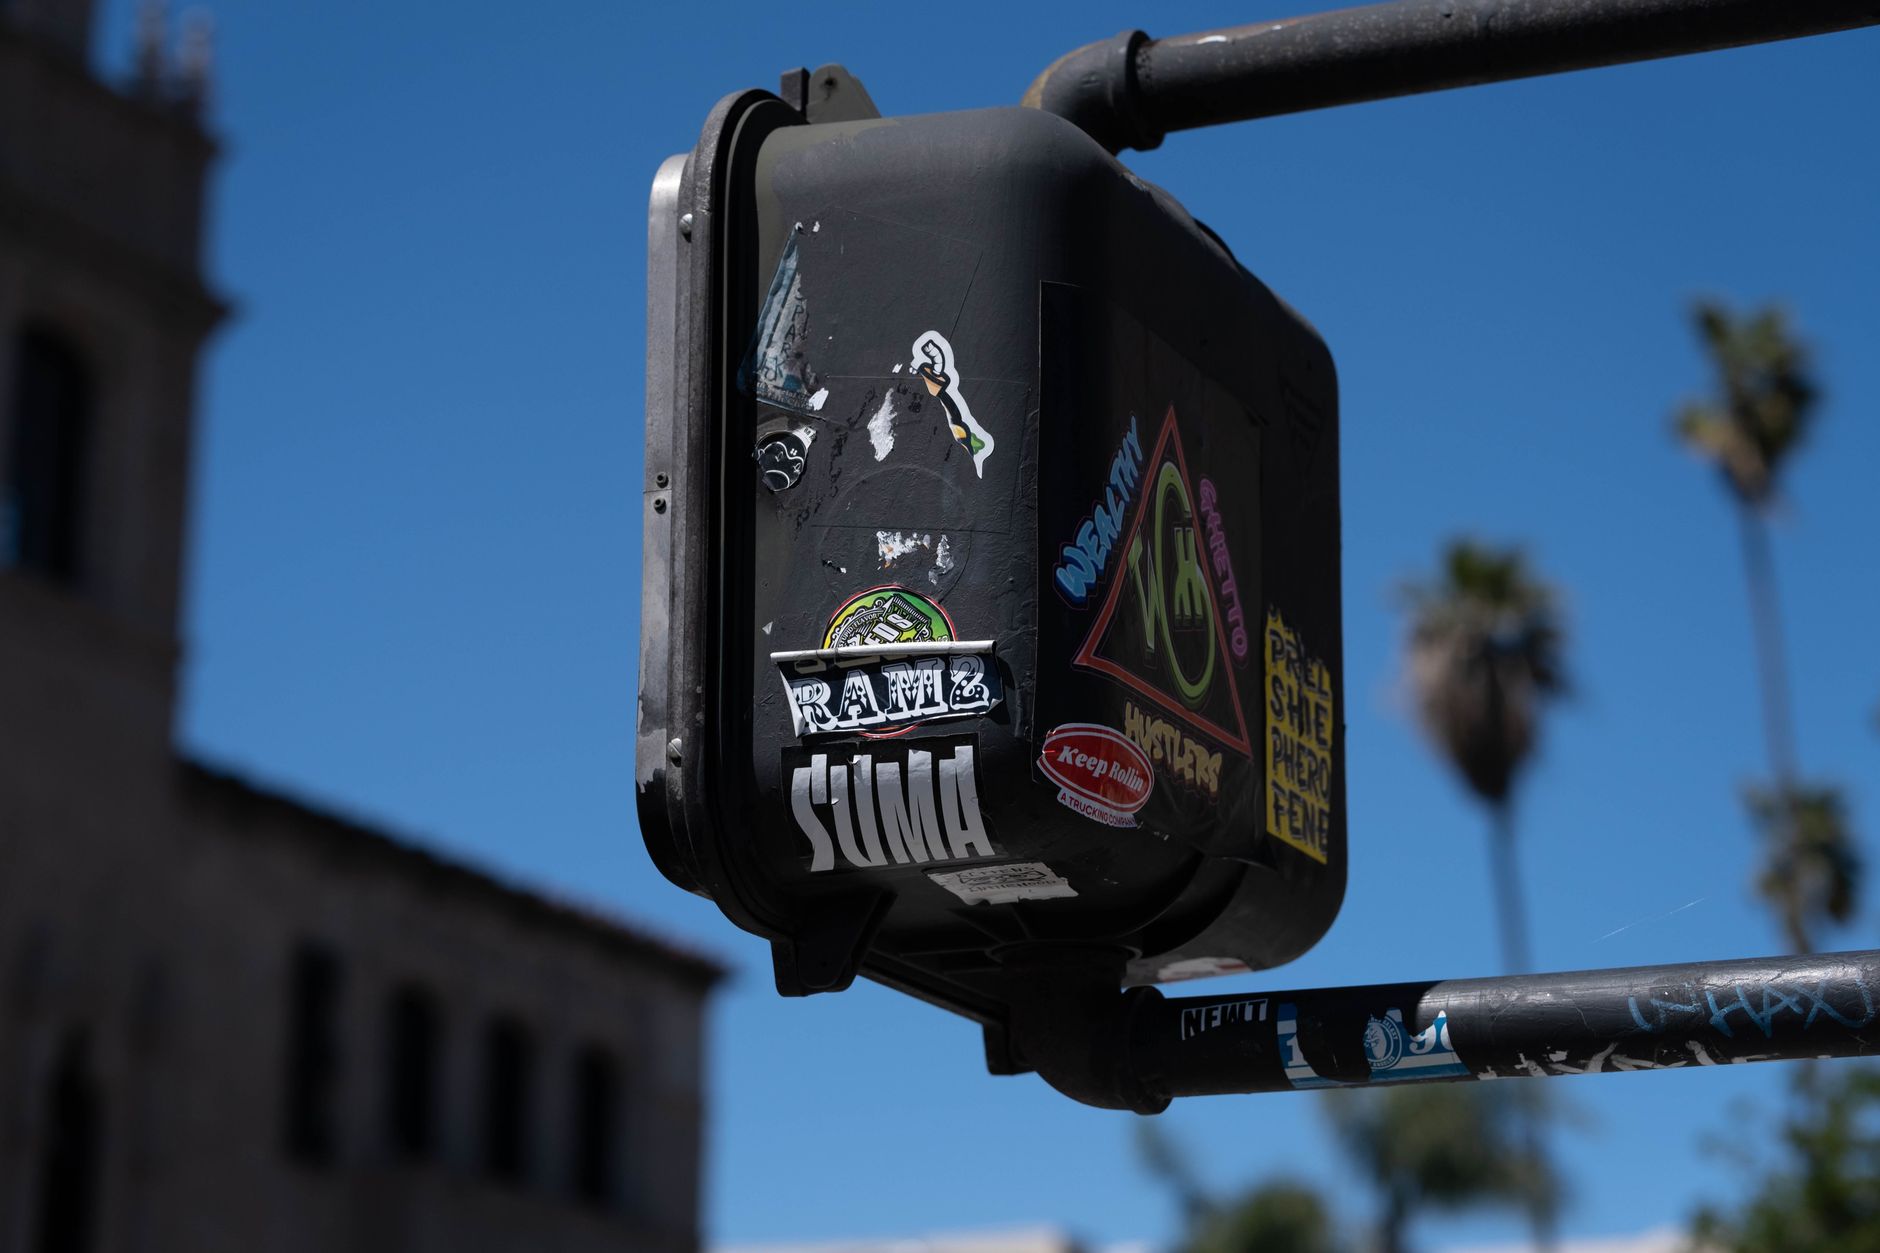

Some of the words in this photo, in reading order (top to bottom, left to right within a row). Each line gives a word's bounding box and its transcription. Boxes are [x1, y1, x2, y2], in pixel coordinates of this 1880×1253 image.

[1055, 414, 1143, 602] WEALTHY
[1200, 477, 1248, 657] GHETTO
[1057, 746, 1108, 777] Keep
[1108, 761, 1144, 792] Rollin
[1124, 701, 1222, 793] HUSTLERS
[791, 746, 995, 872] SUMA
[1060, 792, 1067, 802] A
[1069, 796, 1109, 822] TRUCKING
[1108, 813, 1137, 827] COMPANY
[1182, 999, 1268, 1040] NEWT
